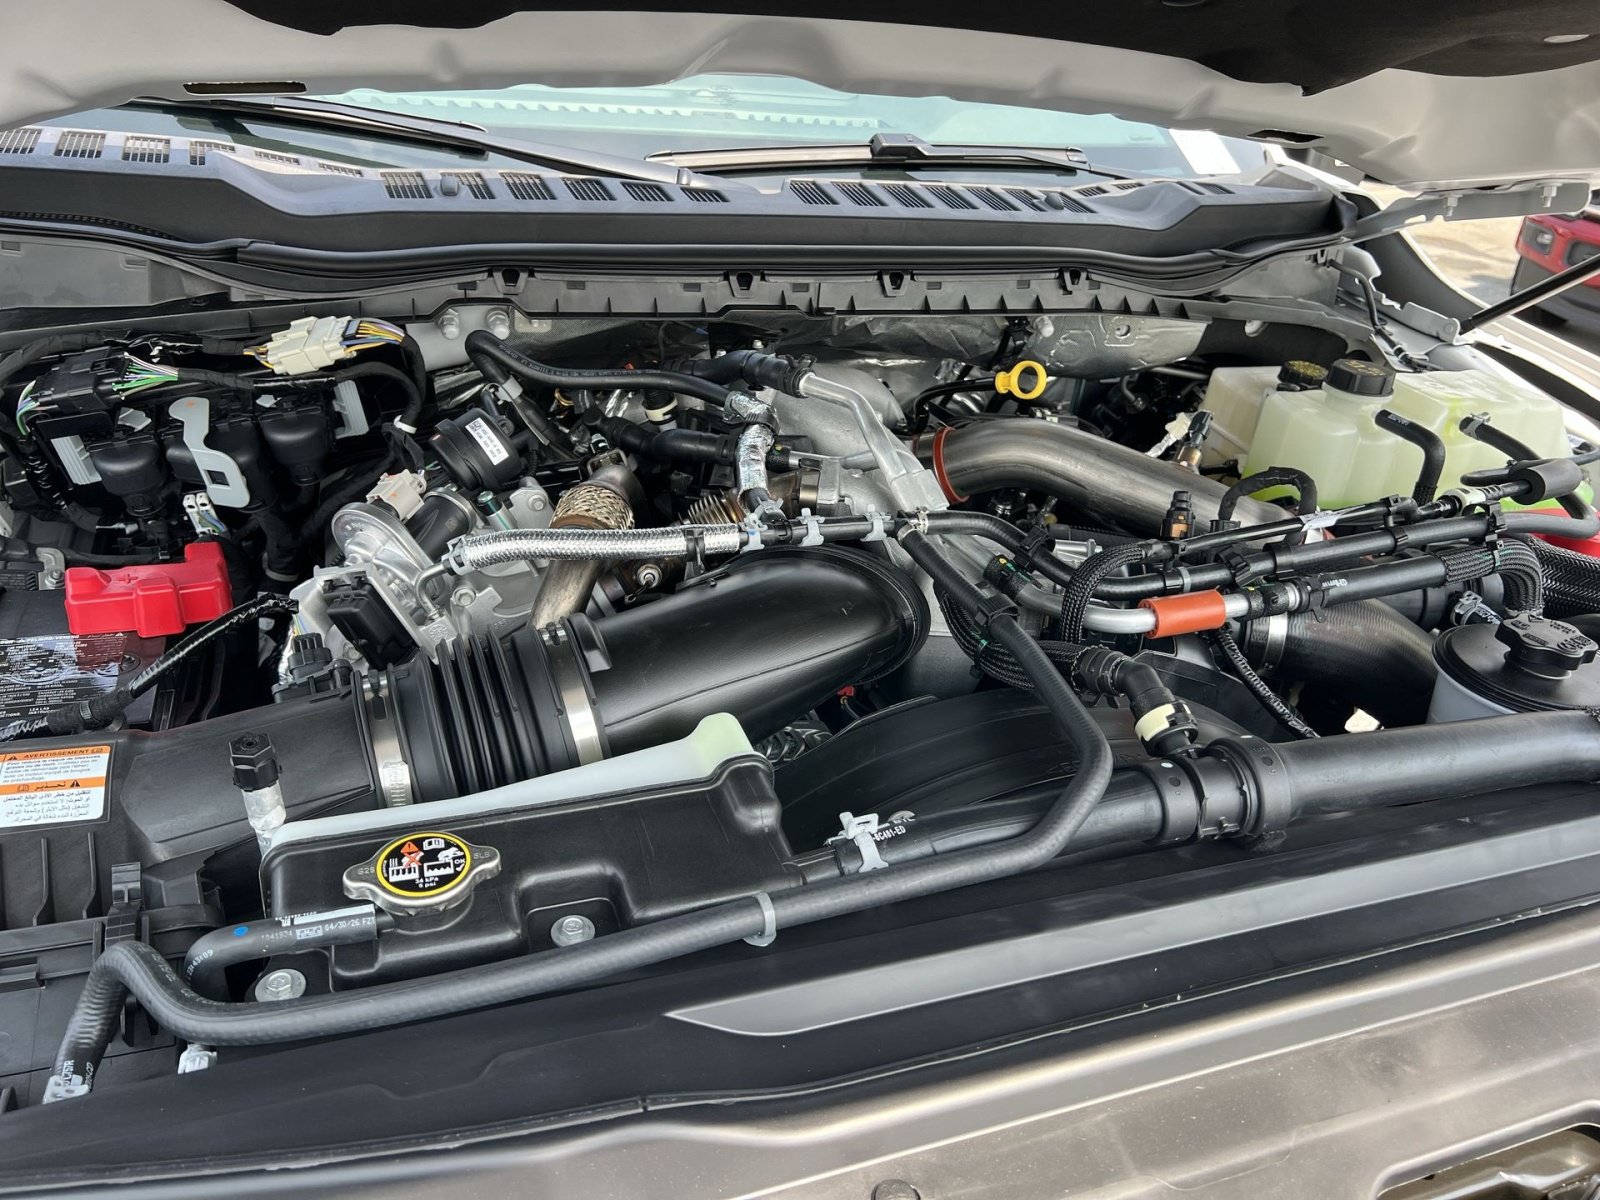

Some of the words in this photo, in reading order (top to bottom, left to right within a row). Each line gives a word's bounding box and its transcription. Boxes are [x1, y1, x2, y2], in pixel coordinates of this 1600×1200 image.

[24, 749, 89, 759] AVERTISSEMENT
[454, 857, 466, 865] OK
[324, 918, 360, 931] 04/30/26
